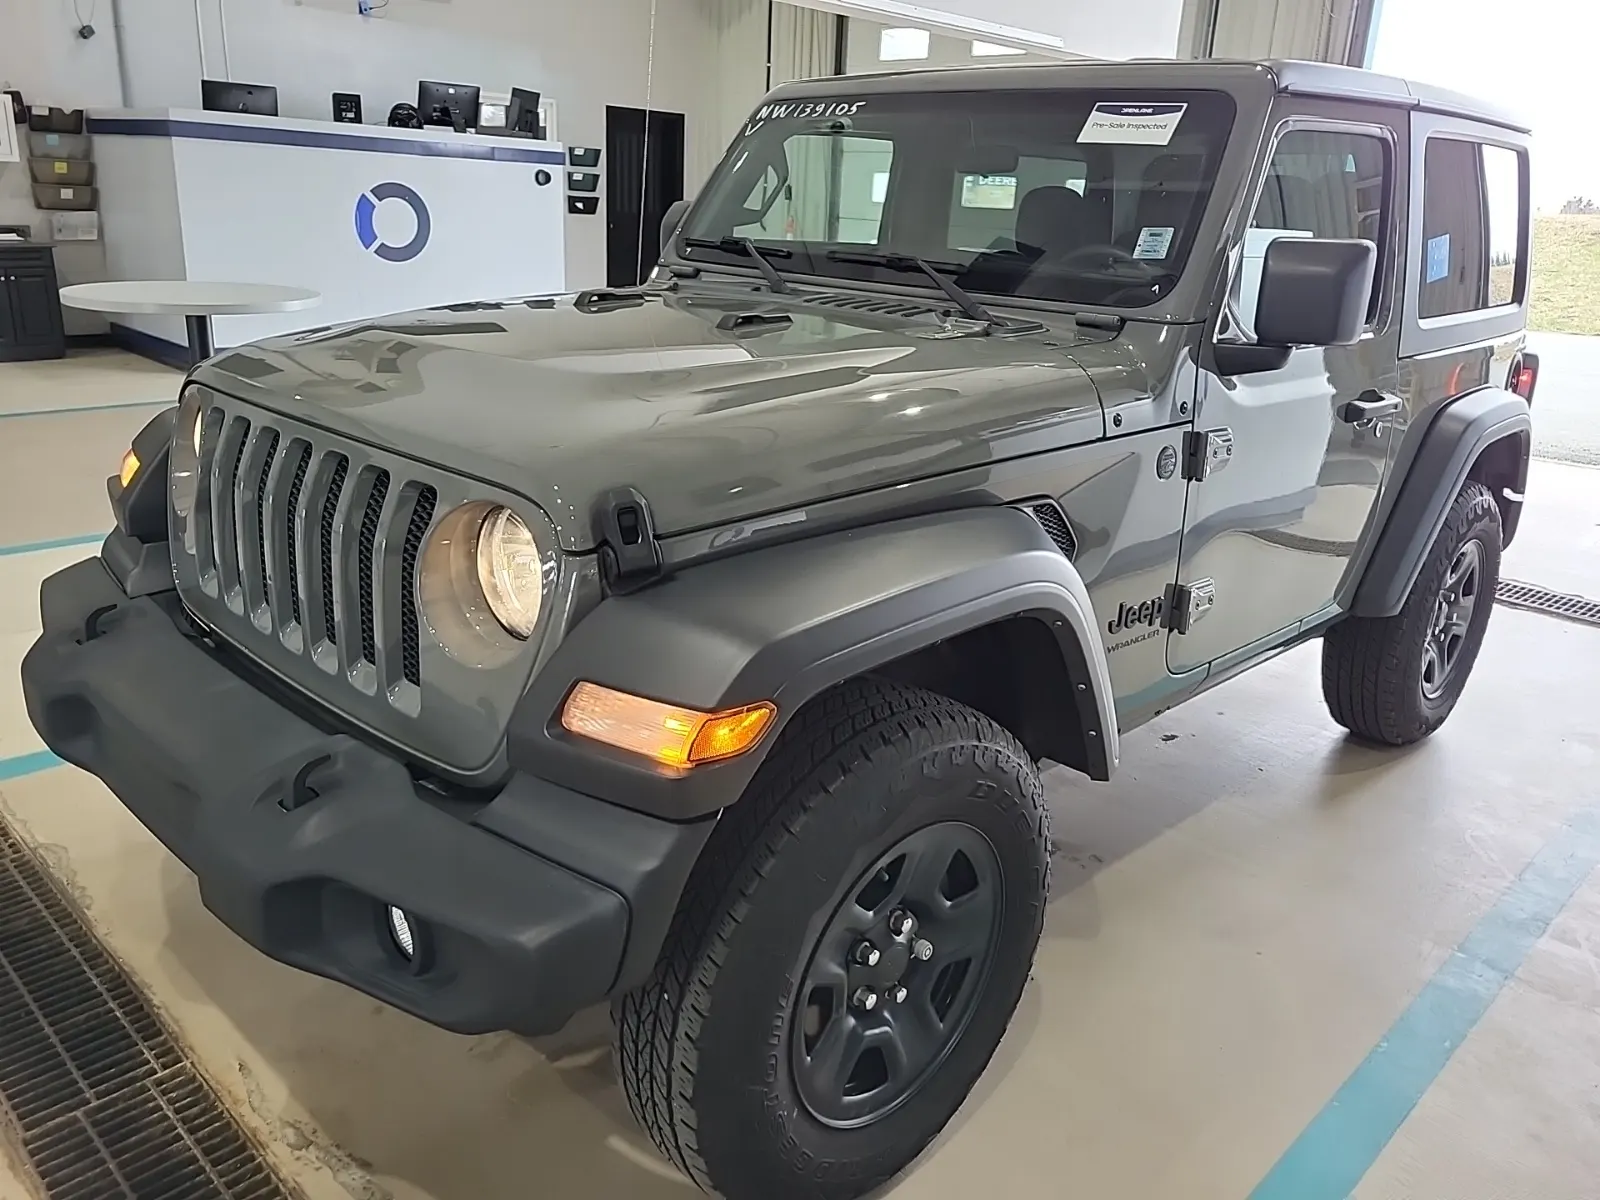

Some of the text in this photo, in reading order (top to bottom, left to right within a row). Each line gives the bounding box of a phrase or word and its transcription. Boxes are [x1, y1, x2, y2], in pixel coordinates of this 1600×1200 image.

[755, 101, 867, 120] NW139105
[1091, 121, 1168, 131] Pre-Sale Inspected
[1107, 596, 1165, 635] Jeep
[1106, 629, 1160, 654] WRANGLER
